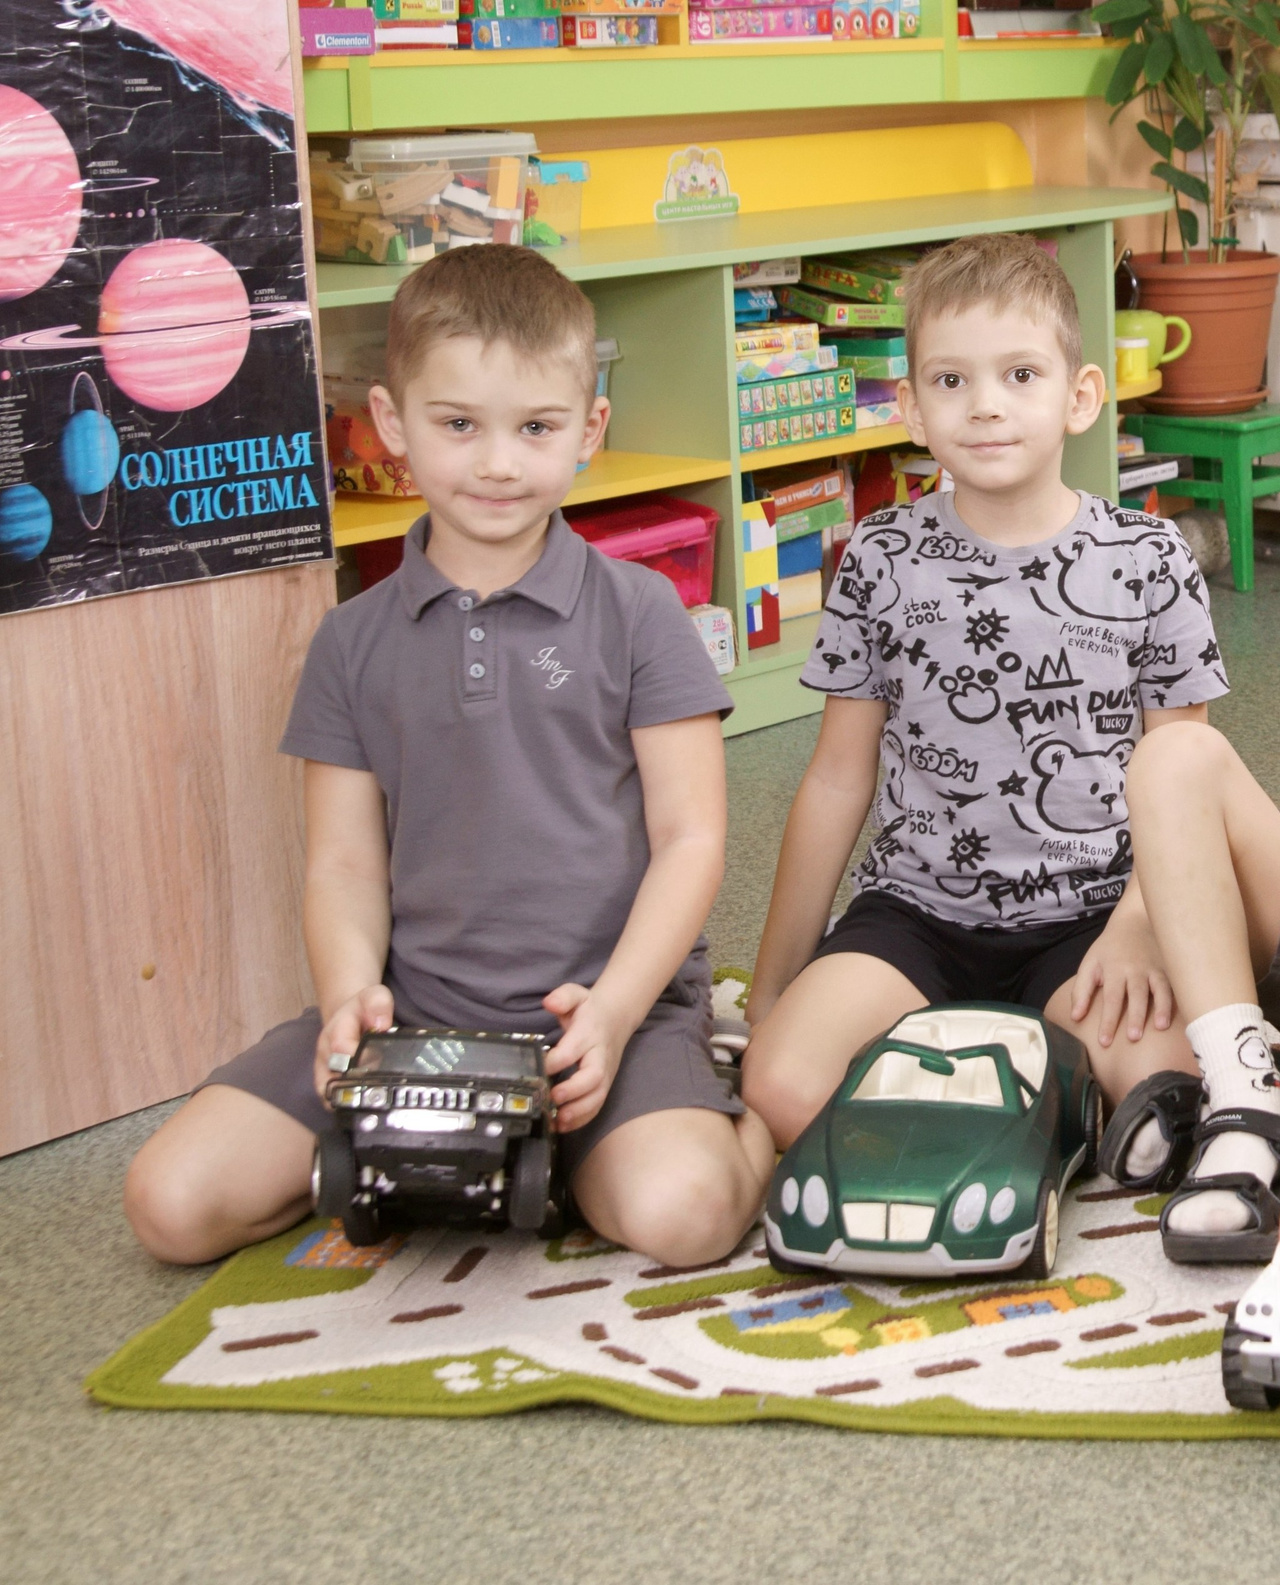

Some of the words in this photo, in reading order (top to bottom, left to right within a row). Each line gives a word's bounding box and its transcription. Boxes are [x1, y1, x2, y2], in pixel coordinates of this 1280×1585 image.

[326, 35, 370, 47] Clementoni
[120, 432, 315, 491] СОЛНЕЧНАЯ
[168, 473, 320, 528] СИСТЕМА
[862, 512, 891, 525] ucky
[1122, 513, 1159, 527] lucky
[138, 542, 179, 557] Размеры
[219, 533, 251, 546] девяти
[252, 523, 321, 541] вращающихся
[233, 543, 263, 556] вокруг
[265, 540, 287, 551] него
[287, 535, 322, 549] планет
[902, 597, 941, 615] stay
[906, 611, 948, 629] COOL
[1060, 622, 1101, 638] FUTURE
[1101, 628, 1138, 650] BEGINS
[1068, 638, 1121, 658] EVERYDAY
[1004, 694, 1081, 744] FUN
[1101, 716, 1129, 731] lucky
[909, 742, 979, 783] BOOM
[908, 802, 936, 823] tay
[1039, 838, 1077, 852] FUTURE
[1079, 841, 1114, 857] BEGINS
[1047, 852, 1100, 867] EVERYDAY
[1090, 882, 1123, 900] lucky
[1205, 1113, 1243, 1127] NORDMAN
